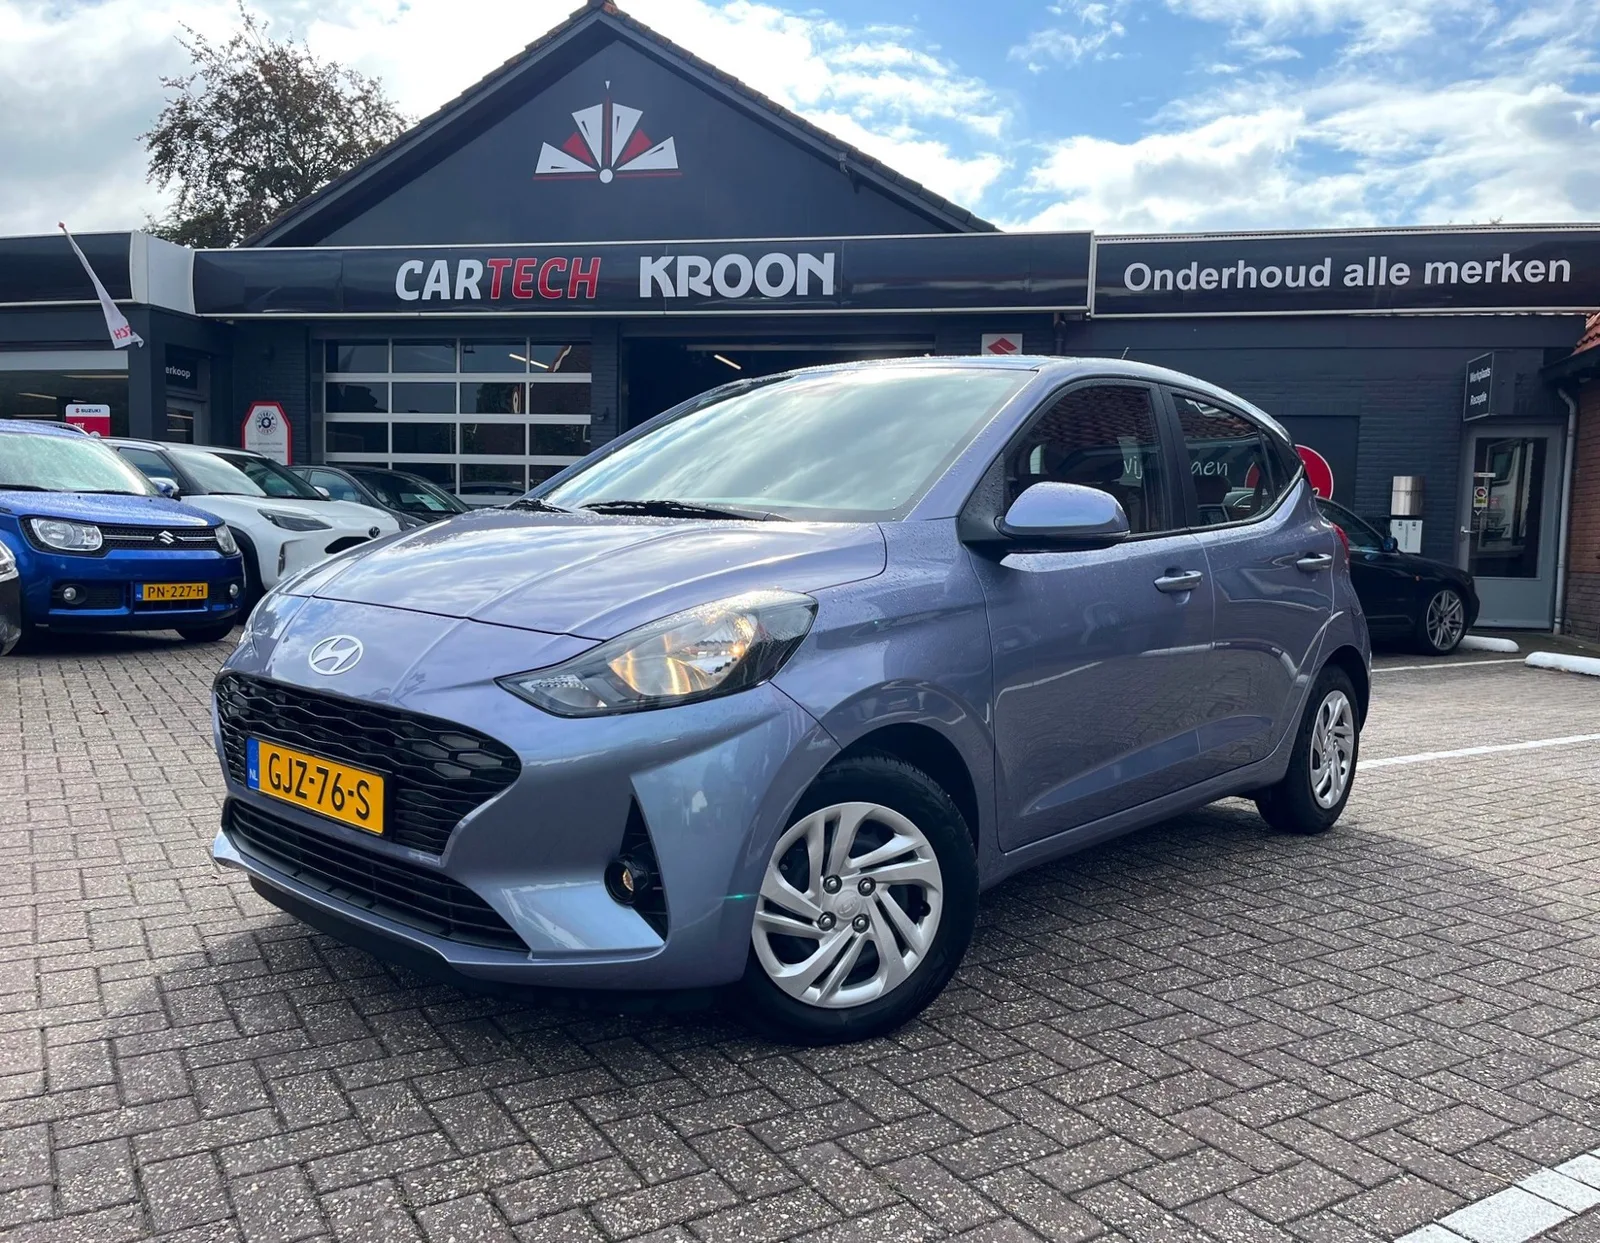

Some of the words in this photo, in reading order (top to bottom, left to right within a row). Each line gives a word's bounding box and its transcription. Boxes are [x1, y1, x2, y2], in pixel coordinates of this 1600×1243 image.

[395, 257, 601, 301] CARTECH
[639, 252, 835, 298] KROON
[1123, 257, 1332, 292] Onderhoud
[1343, 256, 1411, 287] alle
[1423, 253, 1571, 285] merken
[148, 585, 204, 598] PN-227-H
[249, 768, 259, 781] NL
[268, 752, 371, 820] GJZ-76-S
